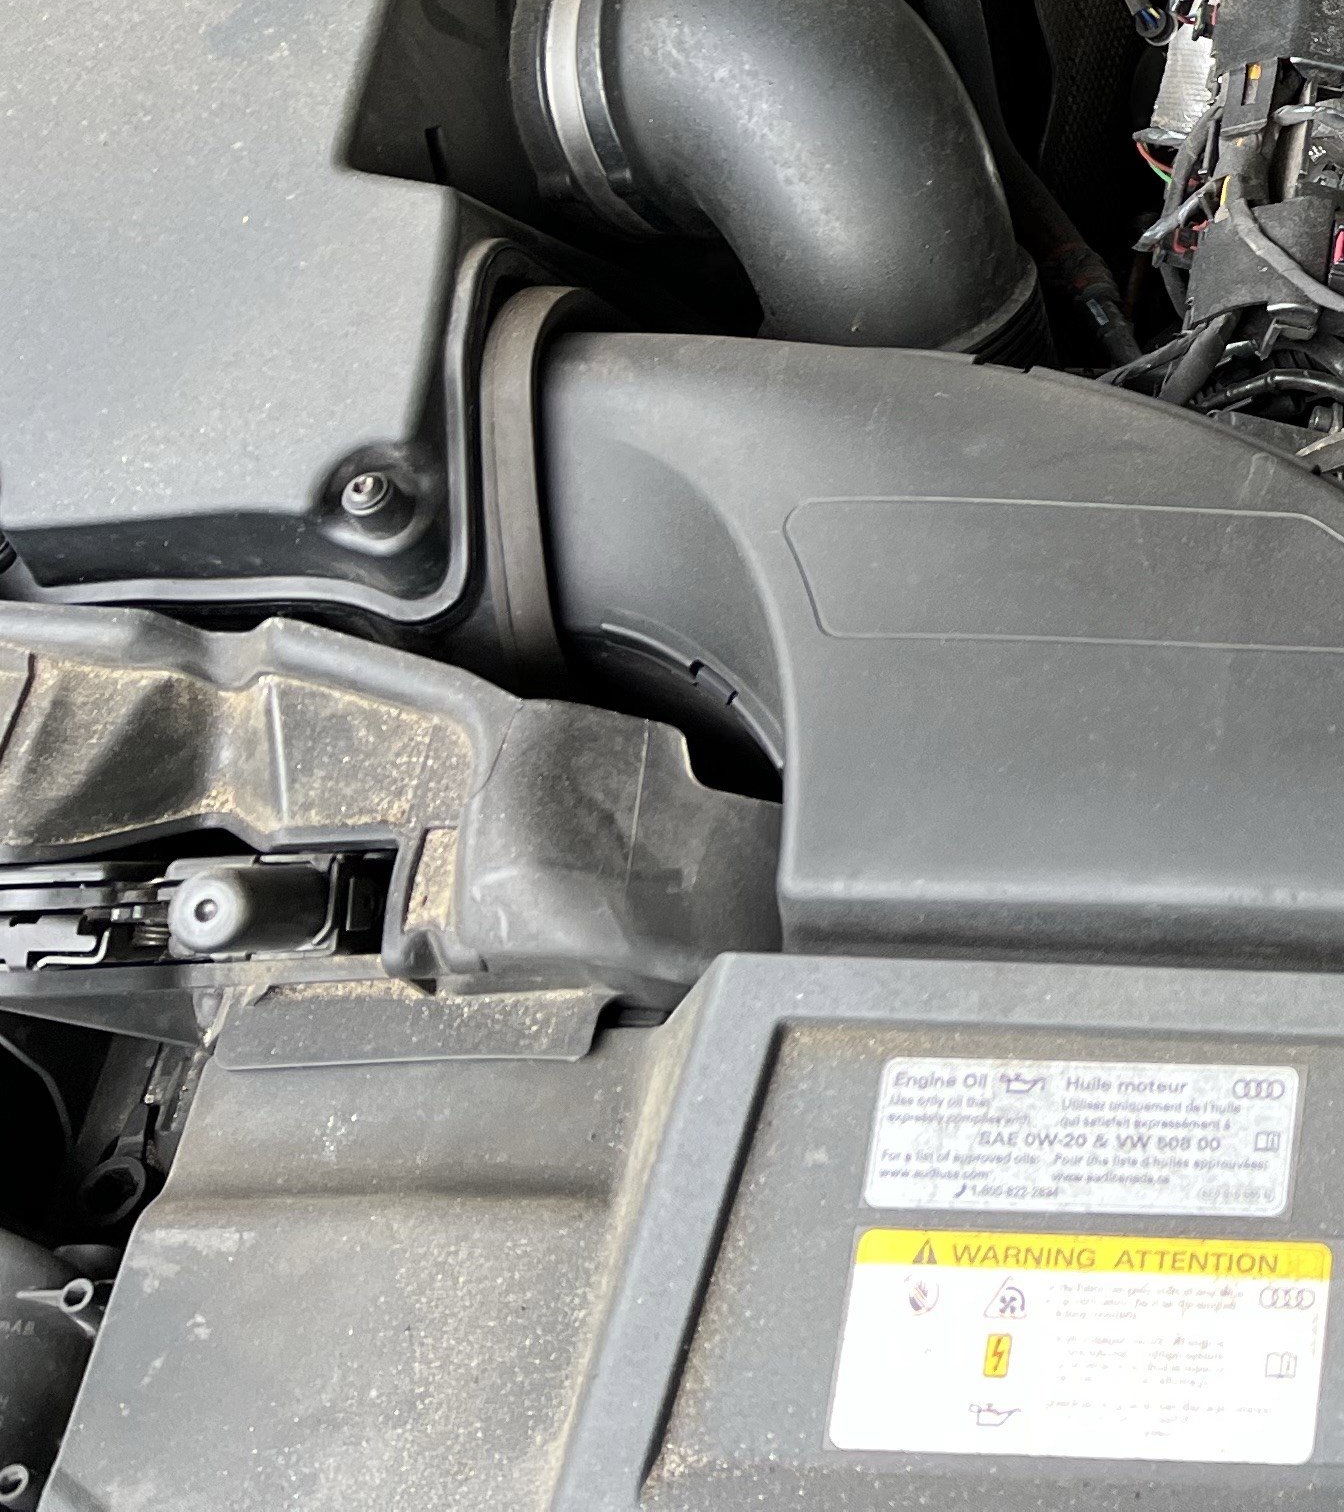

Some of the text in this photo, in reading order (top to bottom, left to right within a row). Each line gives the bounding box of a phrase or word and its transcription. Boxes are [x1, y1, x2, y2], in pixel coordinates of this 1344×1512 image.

[893, 1071, 988, 1089] Engine Oil
[1066, 1076, 1188, 1093] Huile moteur
[1185, 1100, 1200, 1114] de
[978, 1132, 1019, 1147] SAE
[1025, 1132, 1088, 1147] 0W-20
[1093, 1134, 1108, 1149] &
[1115, 1133, 1152, 1150] VW
[1198, 1136, 1221, 1151] 00
[950, 1243, 1280, 1276] WARNING ATTENTION
